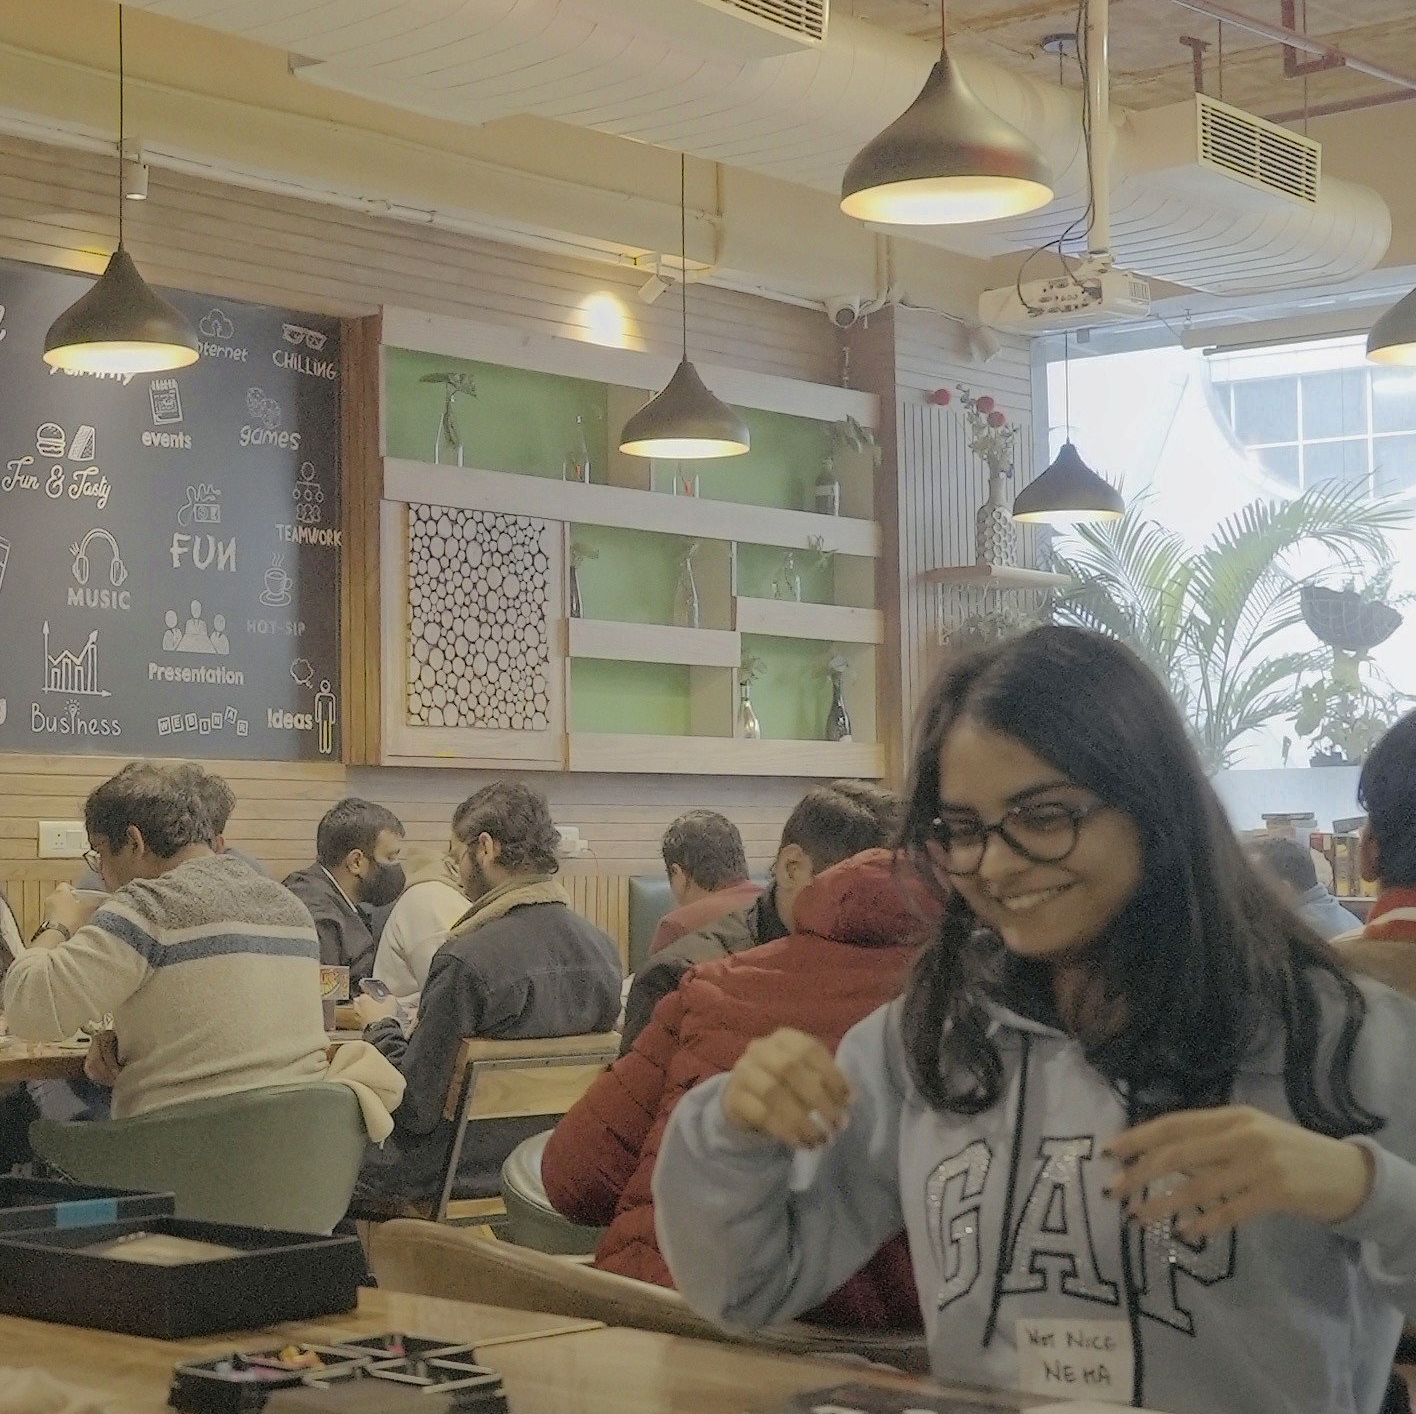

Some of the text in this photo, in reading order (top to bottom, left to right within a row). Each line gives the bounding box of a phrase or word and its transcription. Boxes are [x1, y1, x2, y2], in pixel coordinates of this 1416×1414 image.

[196, 341, 249, 363] ternet
[141, 430, 193, 450] events
[239, 424, 302, 451] games
[1, 454, 112, 510] Fun & Tasty
[275, 523, 343, 547] TEAMWORK
[169, 531, 237, 572] FUN
[67, 587, 131, 611] MUSIC
[246, 619, 306, 636] HOT-SIP
[148, 661, 244, 686] Presentation
[30, 701, 122, 737] Business
[157, 705, 249, 736] WEBINAR
[266, 707, 314, 731] Ideas
